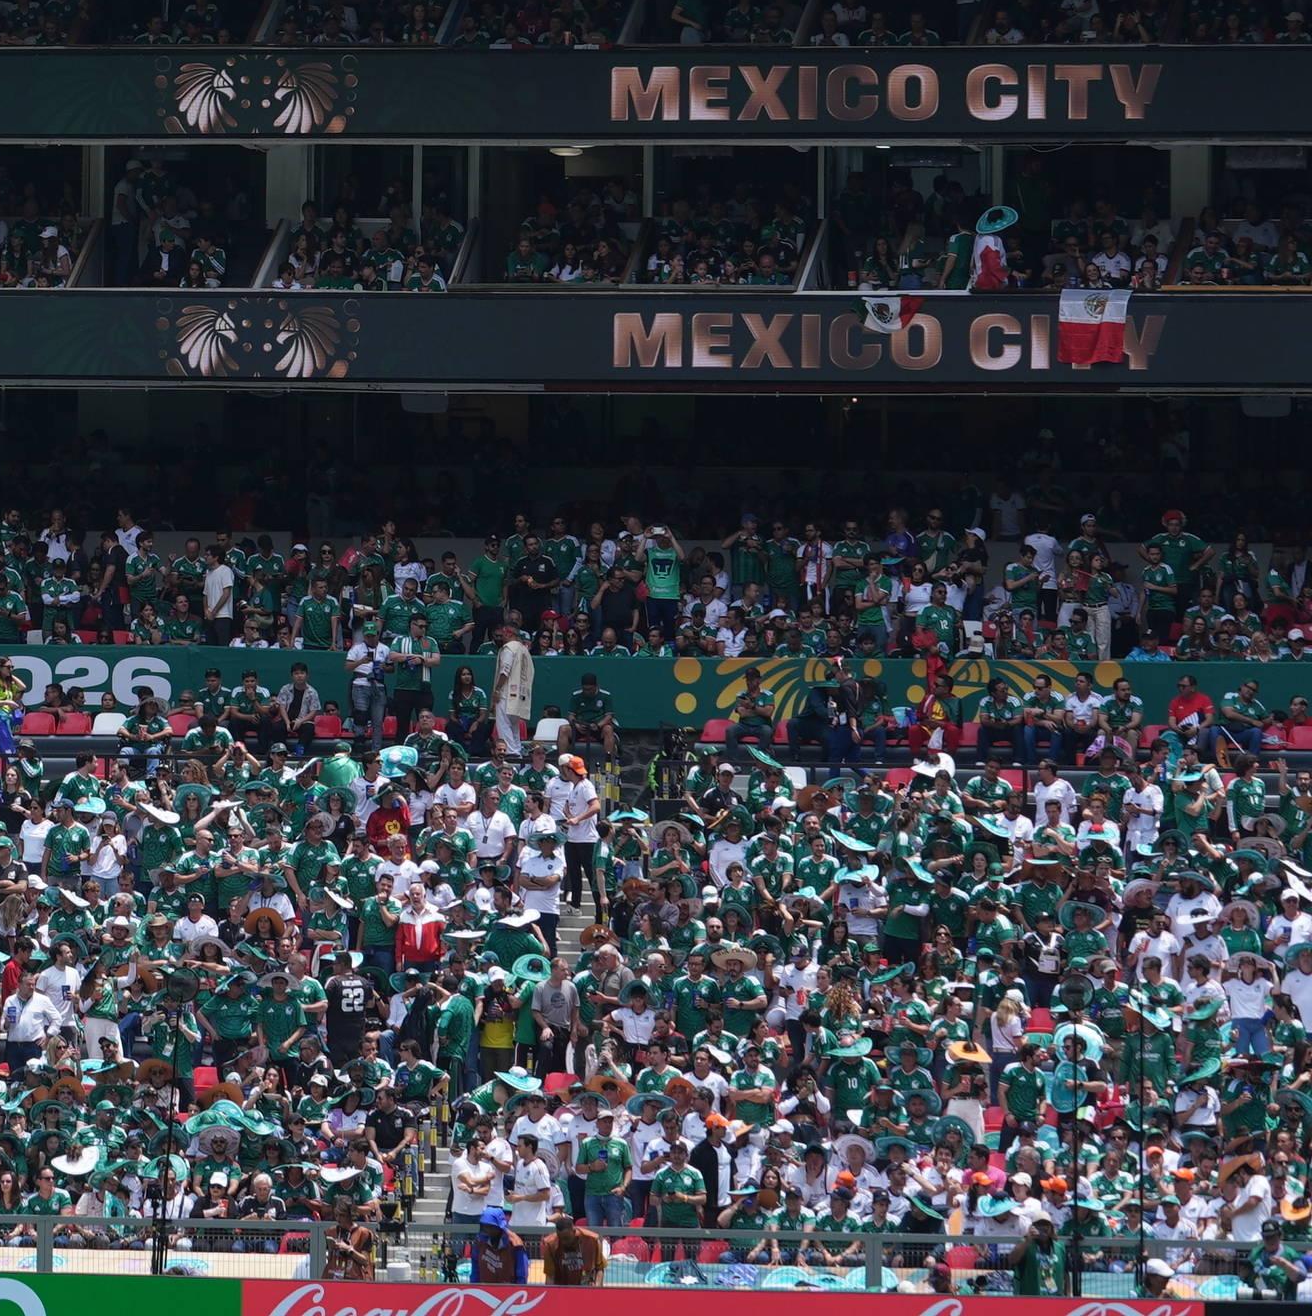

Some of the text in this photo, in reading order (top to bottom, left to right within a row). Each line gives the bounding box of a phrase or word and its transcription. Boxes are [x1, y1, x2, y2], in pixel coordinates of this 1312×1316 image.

[610, 63, 1164, 121] MEXICO CITY
[612, 312, 1168, 372] MEXICO CIY
[341, 986, 365, 1014] 22
[847, 1077, 859, 1090] 10
